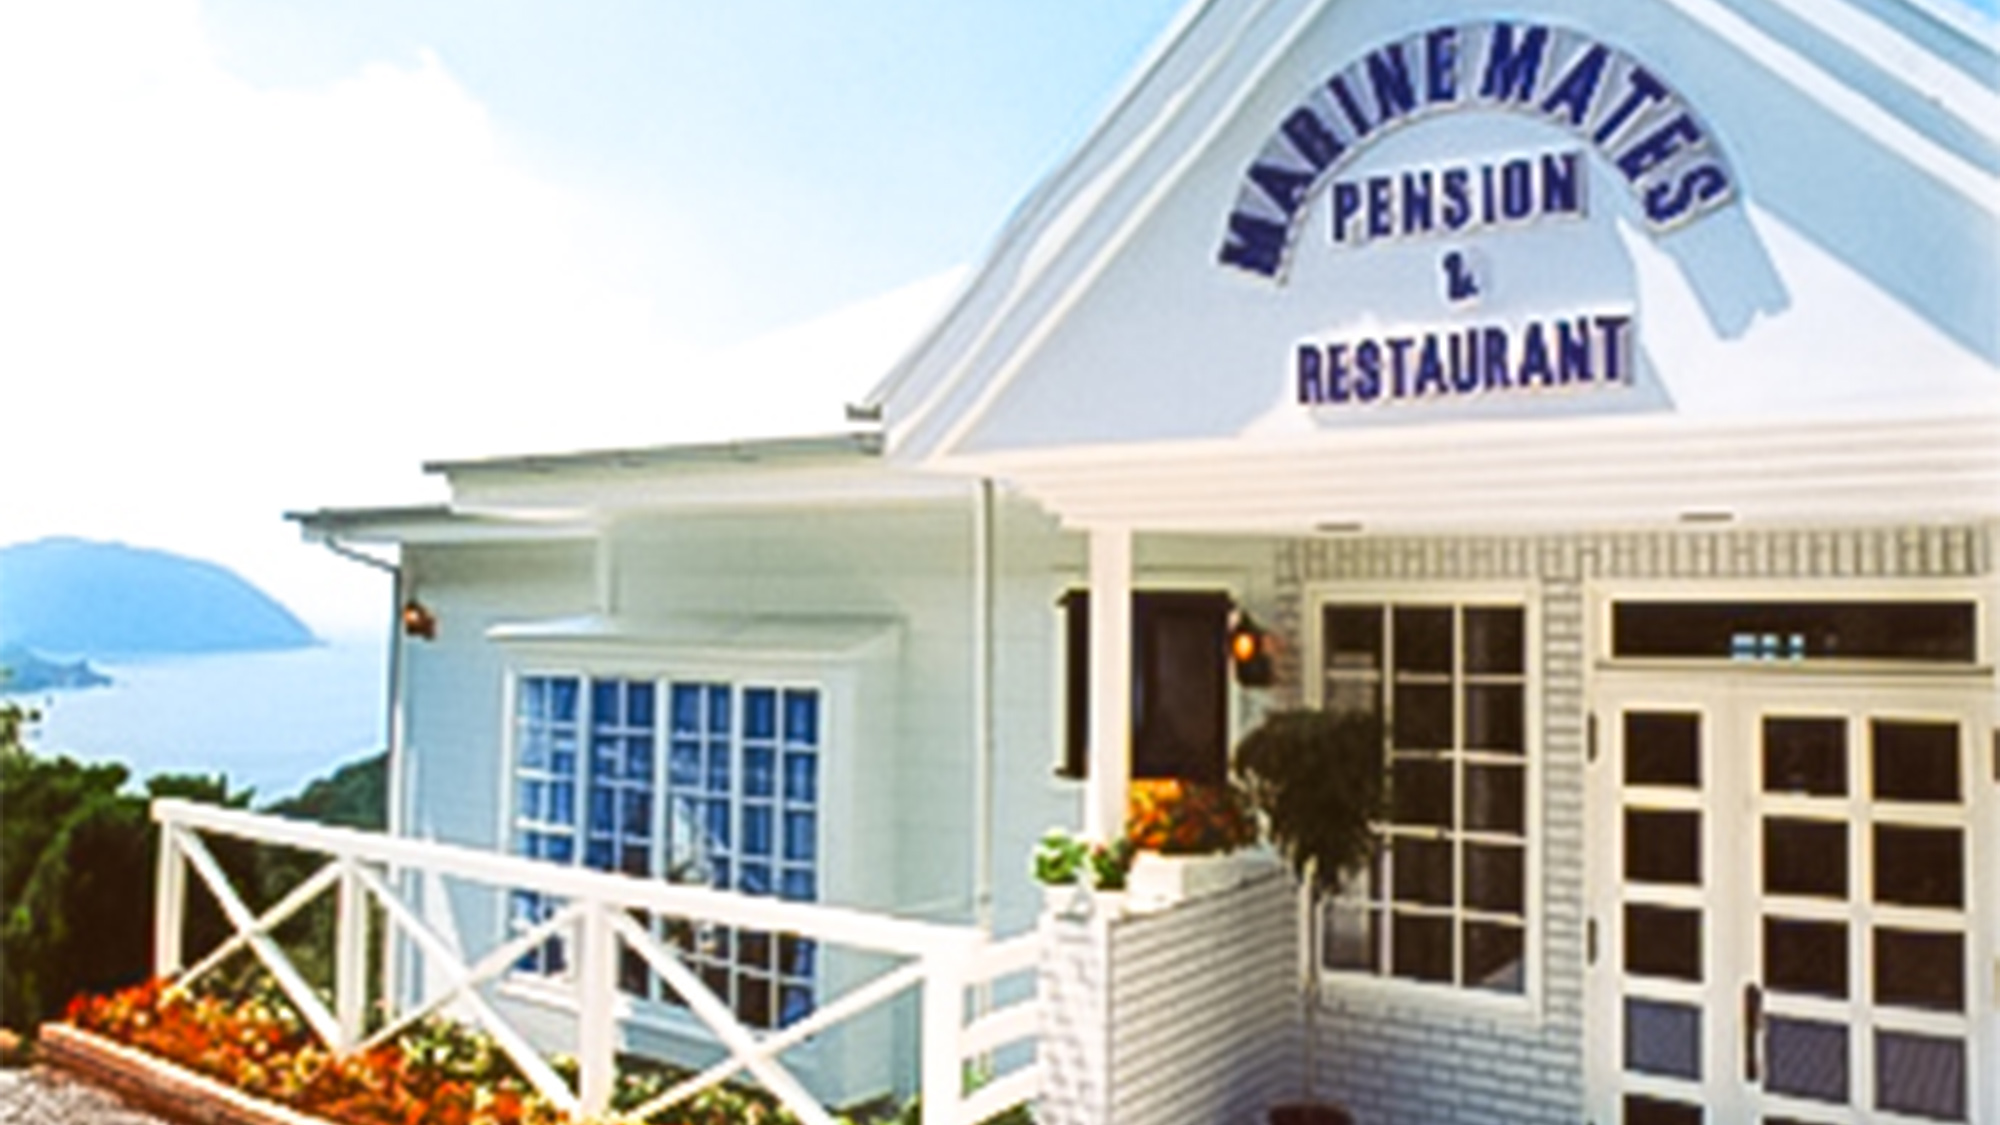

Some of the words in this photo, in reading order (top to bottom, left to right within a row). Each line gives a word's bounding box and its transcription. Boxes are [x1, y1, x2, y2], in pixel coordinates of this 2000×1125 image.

[1218, 27, 1456, 277] MARINE
[1479, 20, 1730, 223] MATES
[1332, 152, 1582, 242] PENSION
[1443, 252, 1479, 301] &
[1297, 316, 1631, 405] RESTAURANT
